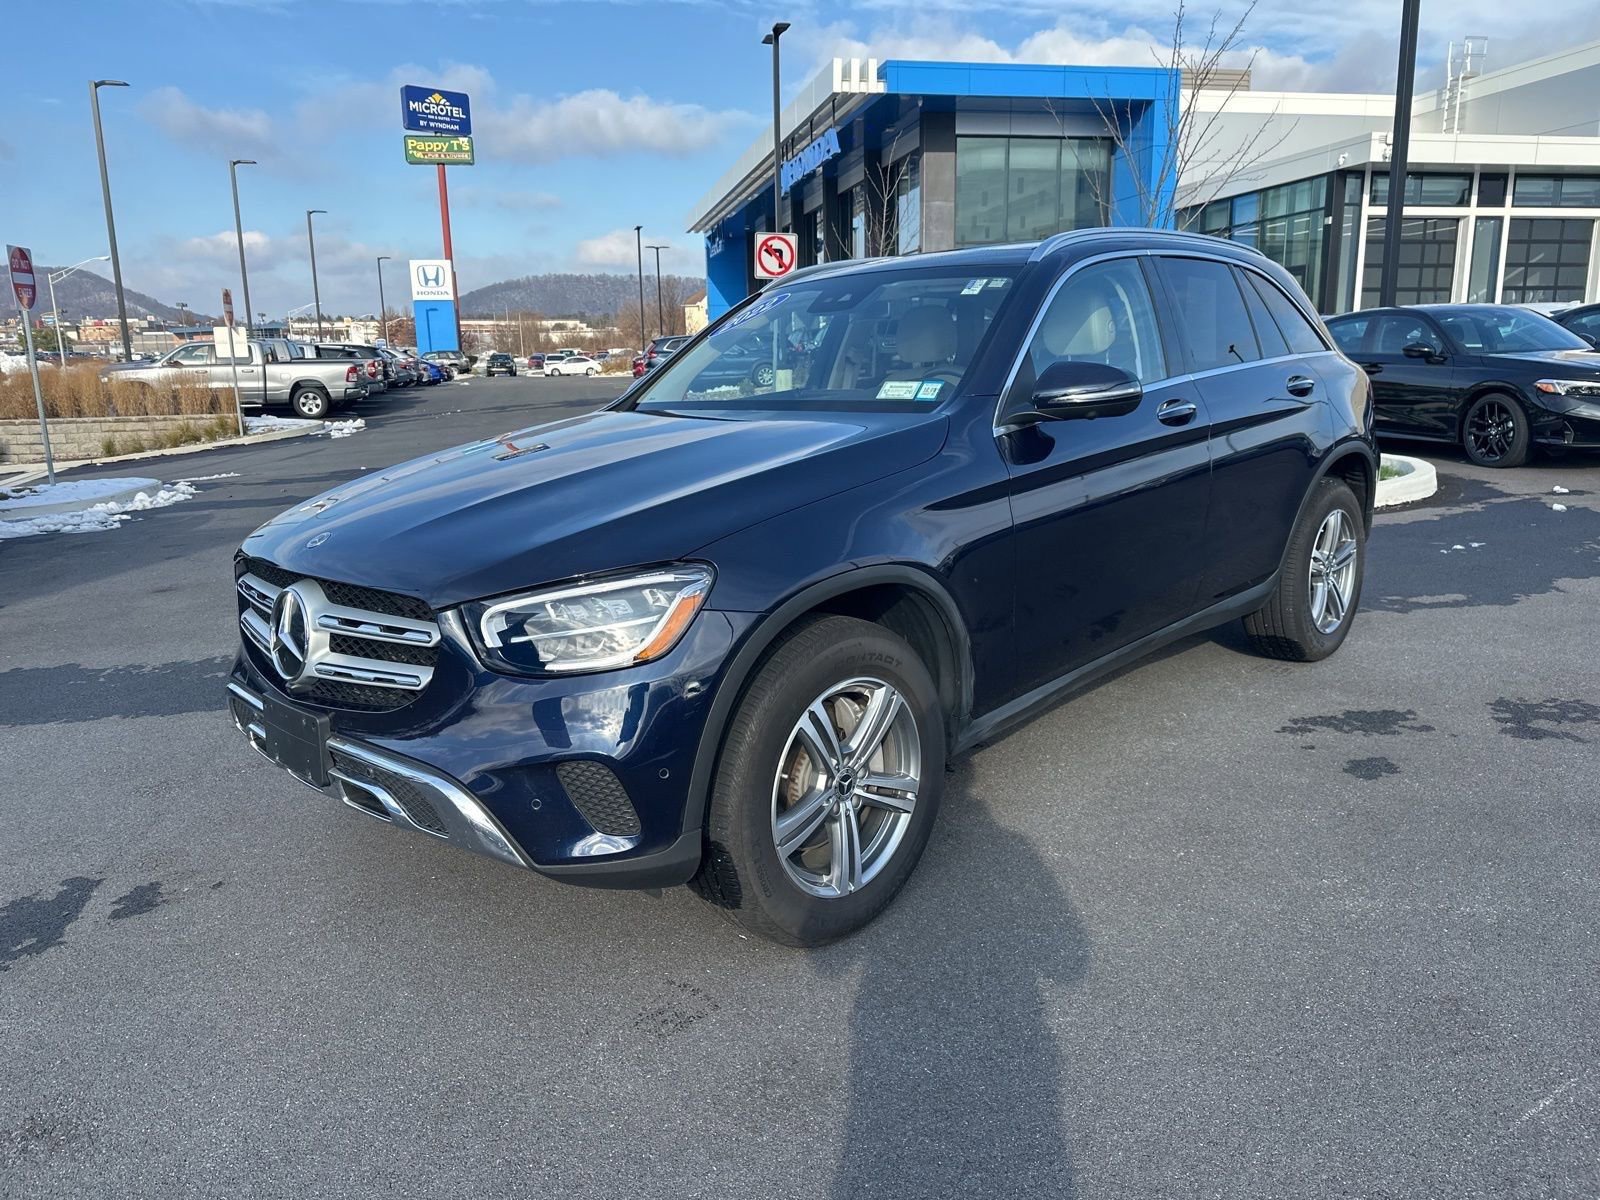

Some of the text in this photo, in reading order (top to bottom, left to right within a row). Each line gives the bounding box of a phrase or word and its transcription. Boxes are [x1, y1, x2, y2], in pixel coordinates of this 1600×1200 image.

[409, 100, 466, 118] MICROTEL
[429, 121, 459, 130] WYNDHAM
[408, 139, 449, 152] Pappy
